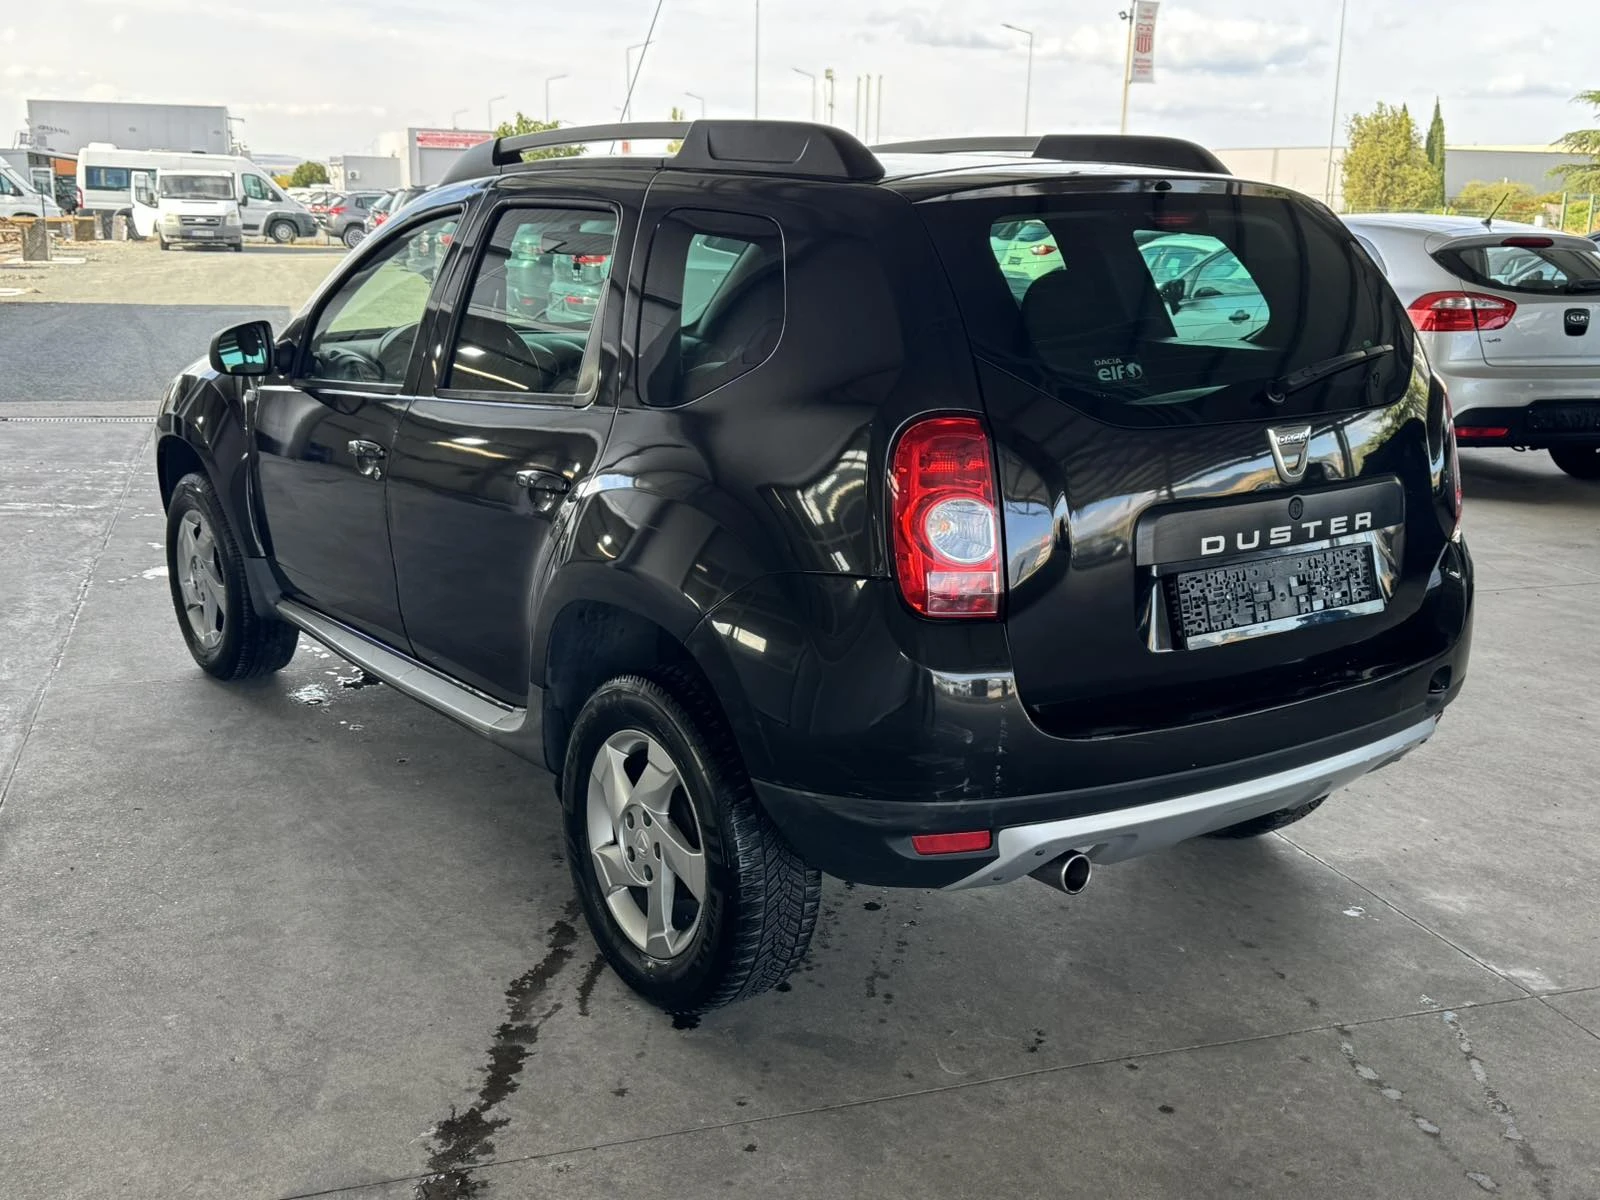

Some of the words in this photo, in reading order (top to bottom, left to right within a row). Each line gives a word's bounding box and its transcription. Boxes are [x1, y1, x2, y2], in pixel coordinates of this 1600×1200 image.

[1094, 358, 1122, 366] DACIA
[1097, 365, 1125, 381] elf
[1278, 433, 1307, 444] DACIA
[1200, 511, 1372, 556] DUSTER
